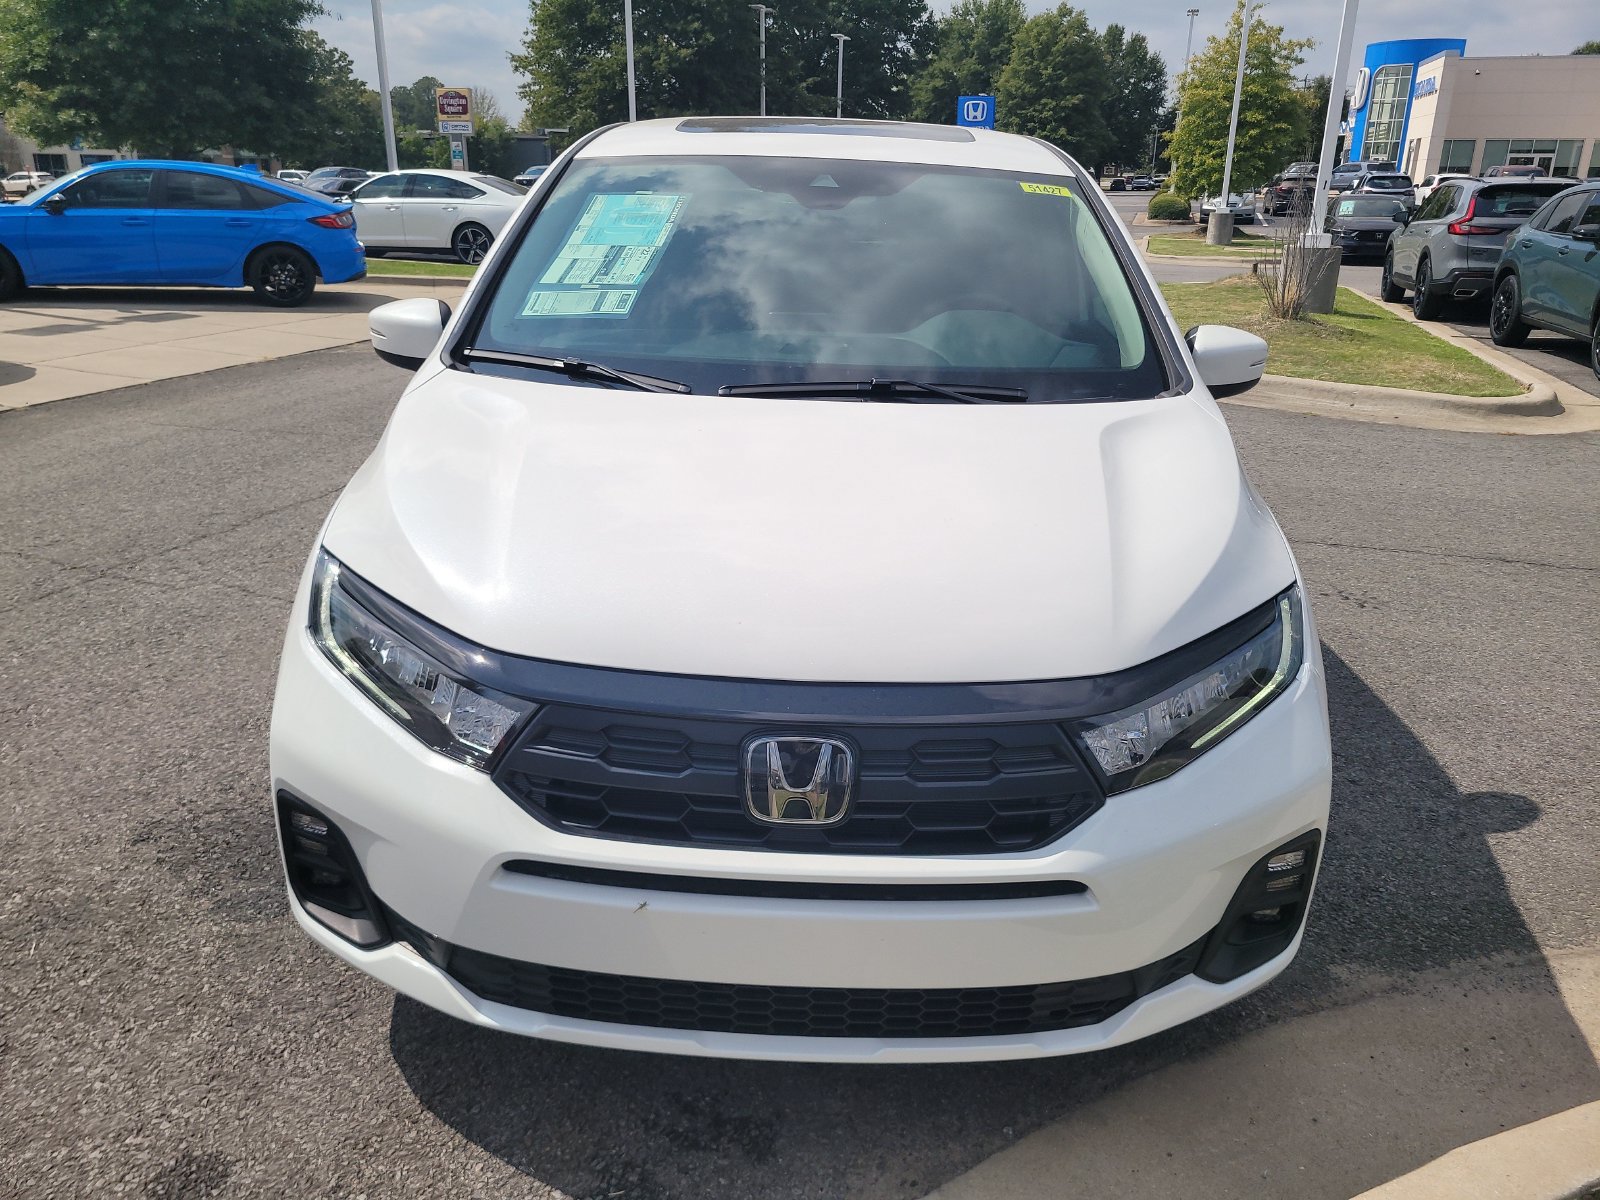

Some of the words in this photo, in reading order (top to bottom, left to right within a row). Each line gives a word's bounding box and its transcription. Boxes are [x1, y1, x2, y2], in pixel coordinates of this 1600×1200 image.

[439, 97, 467, 107] Covington
[444, 105, 463, 114] Square
[1028, 184, 1062, 195] 51427
